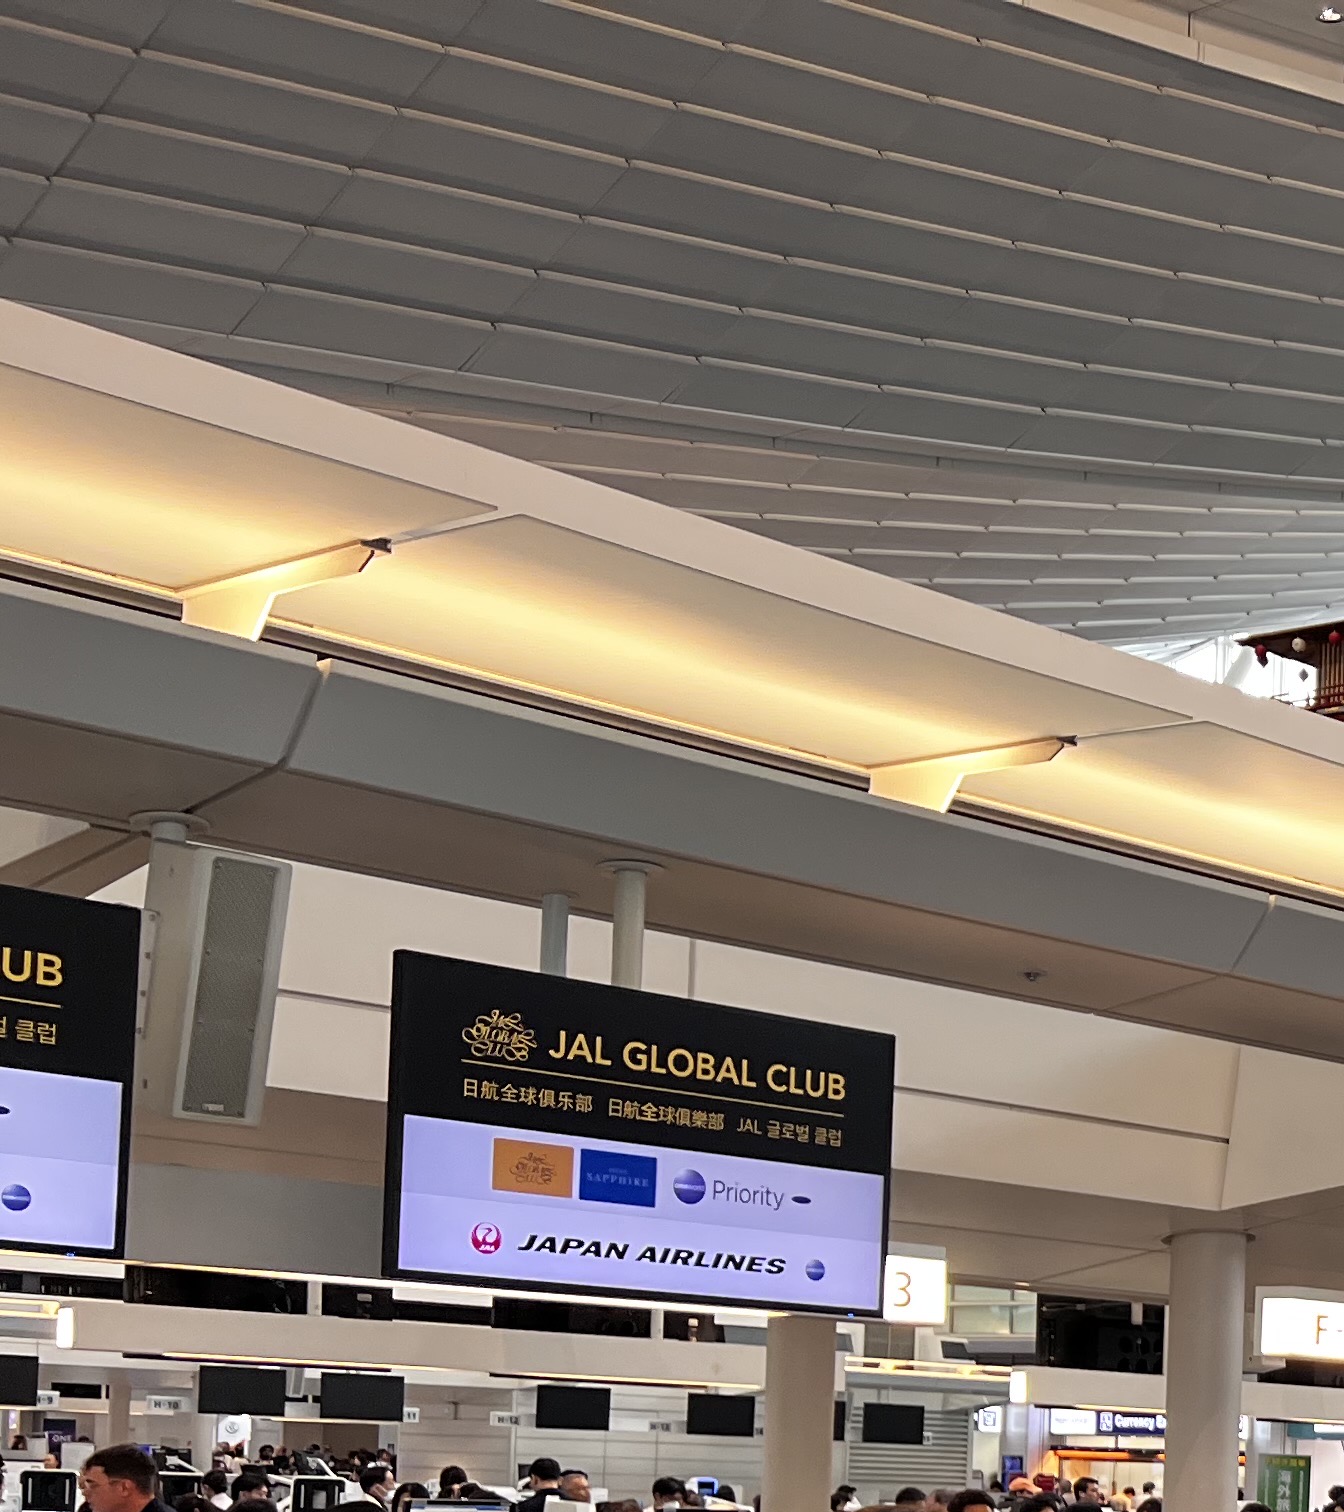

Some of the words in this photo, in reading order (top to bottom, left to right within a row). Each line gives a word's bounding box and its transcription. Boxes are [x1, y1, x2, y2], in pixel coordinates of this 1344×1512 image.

[2, 947, 63, 986] UB
[549, 1030, 612, 1066] JAL
[623, 1041, 757, 1088] GLOBAL
[766, 1064, 846, 1100] CLUB
[463, 1078, 593, 1112] 日航全球俱乐部
[736, 1117, 762, 1136] JAL
[713, 1180, 784, 1211] Priority
[517, 1235, 630, 1261] JAPAN
[635, 1246, 787, 1275] AIRLINES
